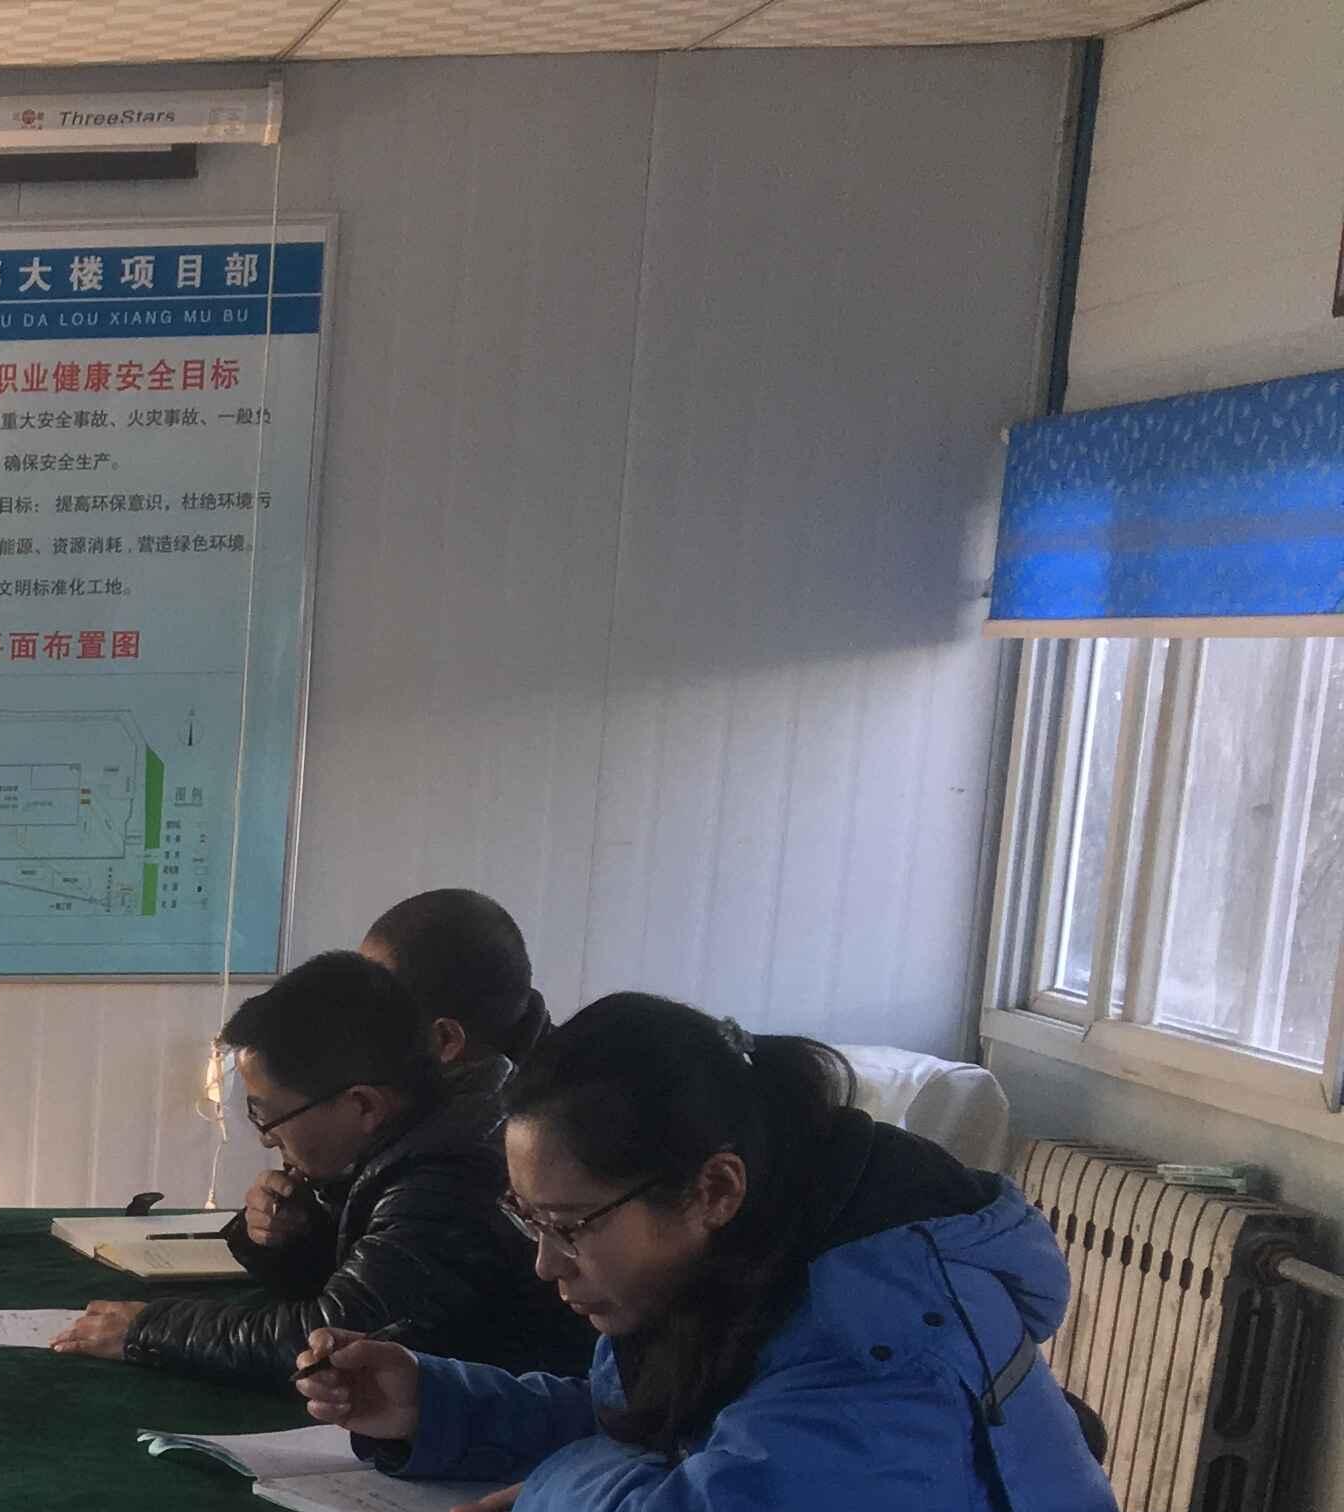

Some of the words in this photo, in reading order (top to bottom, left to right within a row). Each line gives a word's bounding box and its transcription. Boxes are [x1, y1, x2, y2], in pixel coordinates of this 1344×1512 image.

[60, 109, 175, 126] ThreeStars
[23, 312, 49, 327] DA
[59, 311, 99, 326] LOU
[109, 310, 172, 326] XIANG
[183, 309, 212, 324] MU
[223, 308, 249, 323] BU
